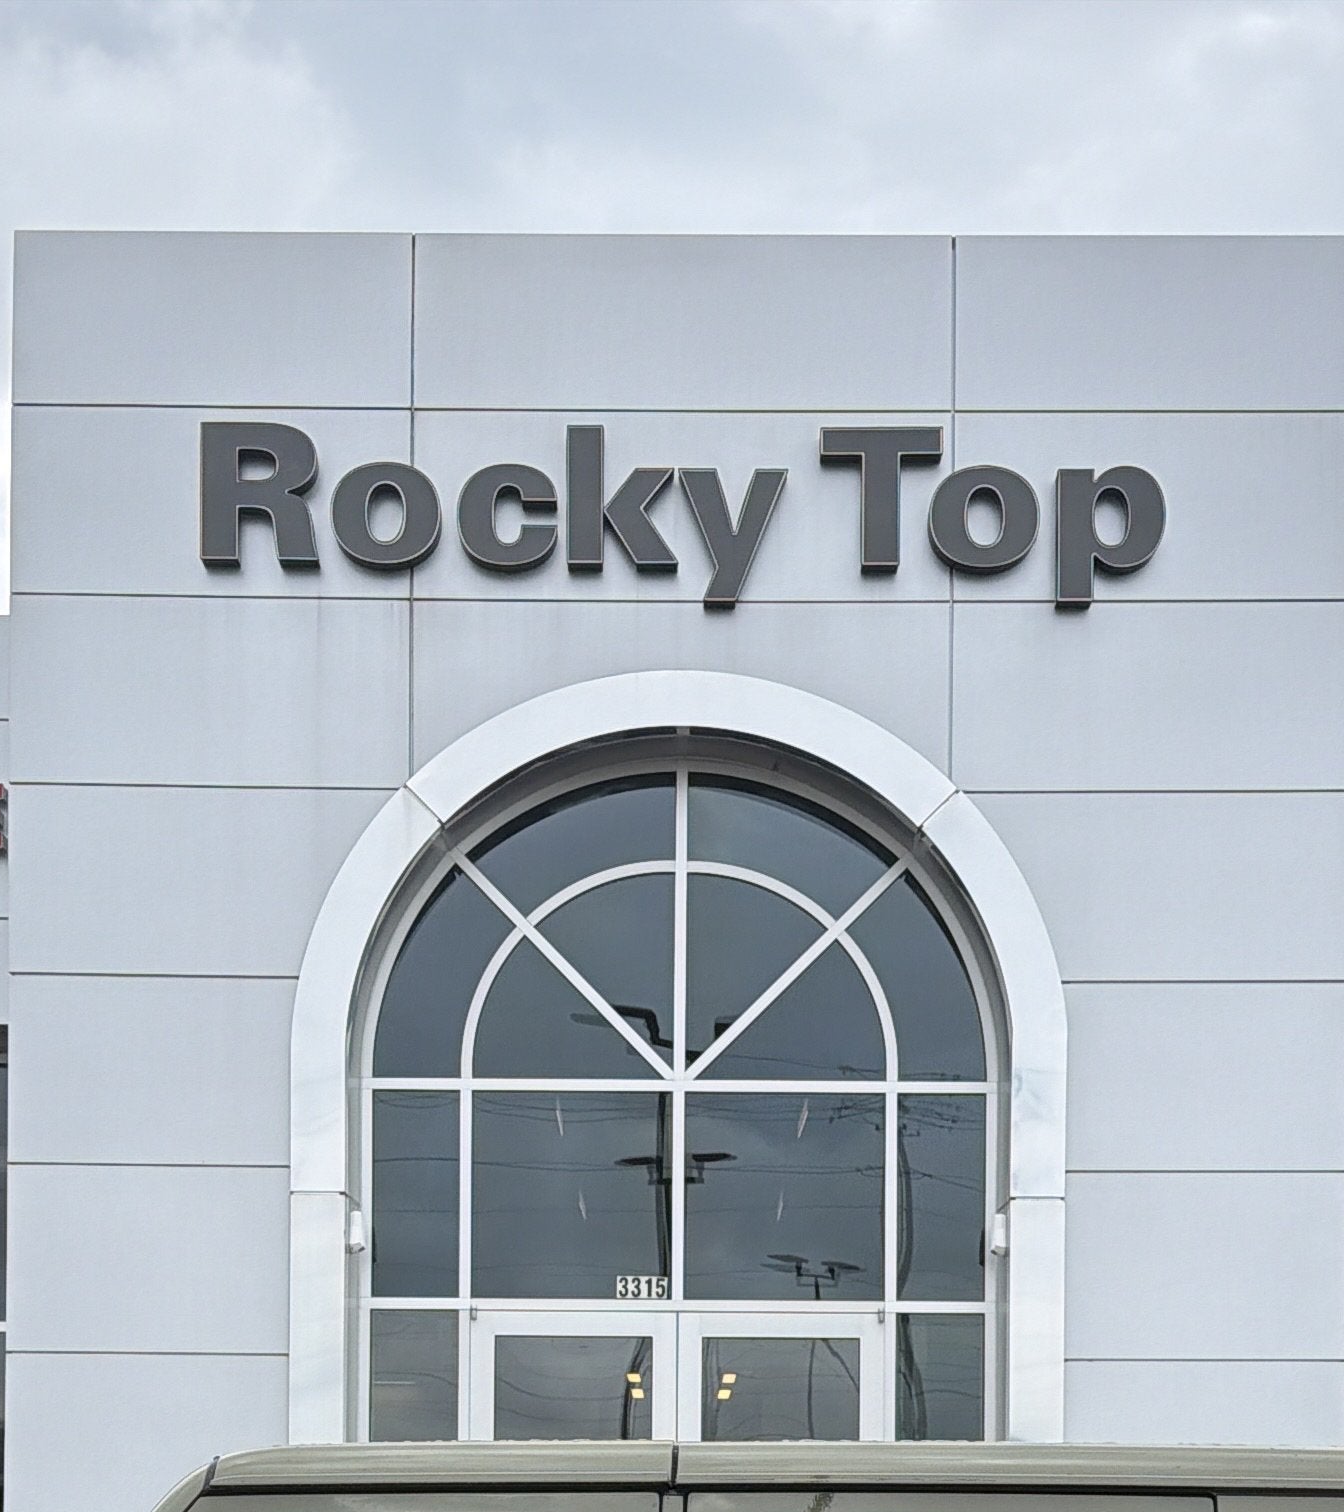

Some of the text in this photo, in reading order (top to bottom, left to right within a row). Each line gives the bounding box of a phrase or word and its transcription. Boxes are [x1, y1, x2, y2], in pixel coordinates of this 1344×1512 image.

[199, 420, 1167, 609] Rocky Top
[618, 1276, 666, 1298] 3315
